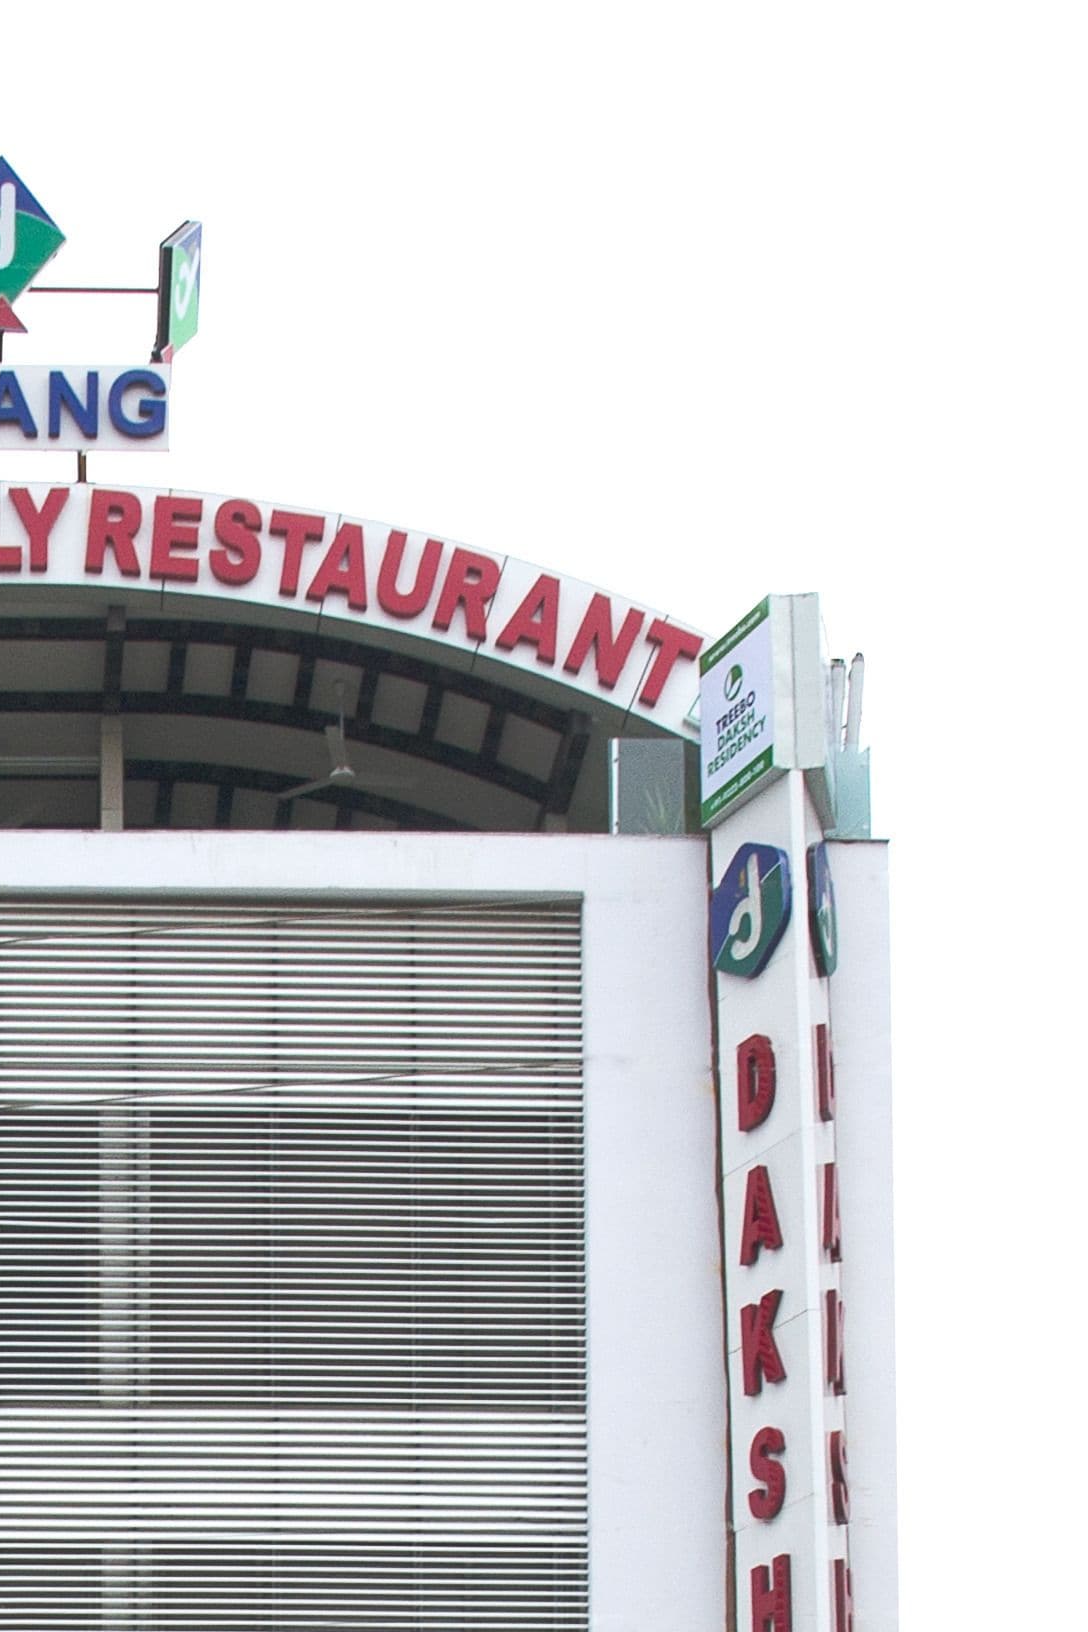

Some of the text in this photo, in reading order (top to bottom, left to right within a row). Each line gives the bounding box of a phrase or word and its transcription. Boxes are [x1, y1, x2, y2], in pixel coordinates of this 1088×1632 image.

[84, 488, 704, 708] RESTAURANT
[716, 690, 756, 735] TREEBO
[717, 707, 755, 752] DAKSH
[707, 715, 767, 777] RESIDENCY
